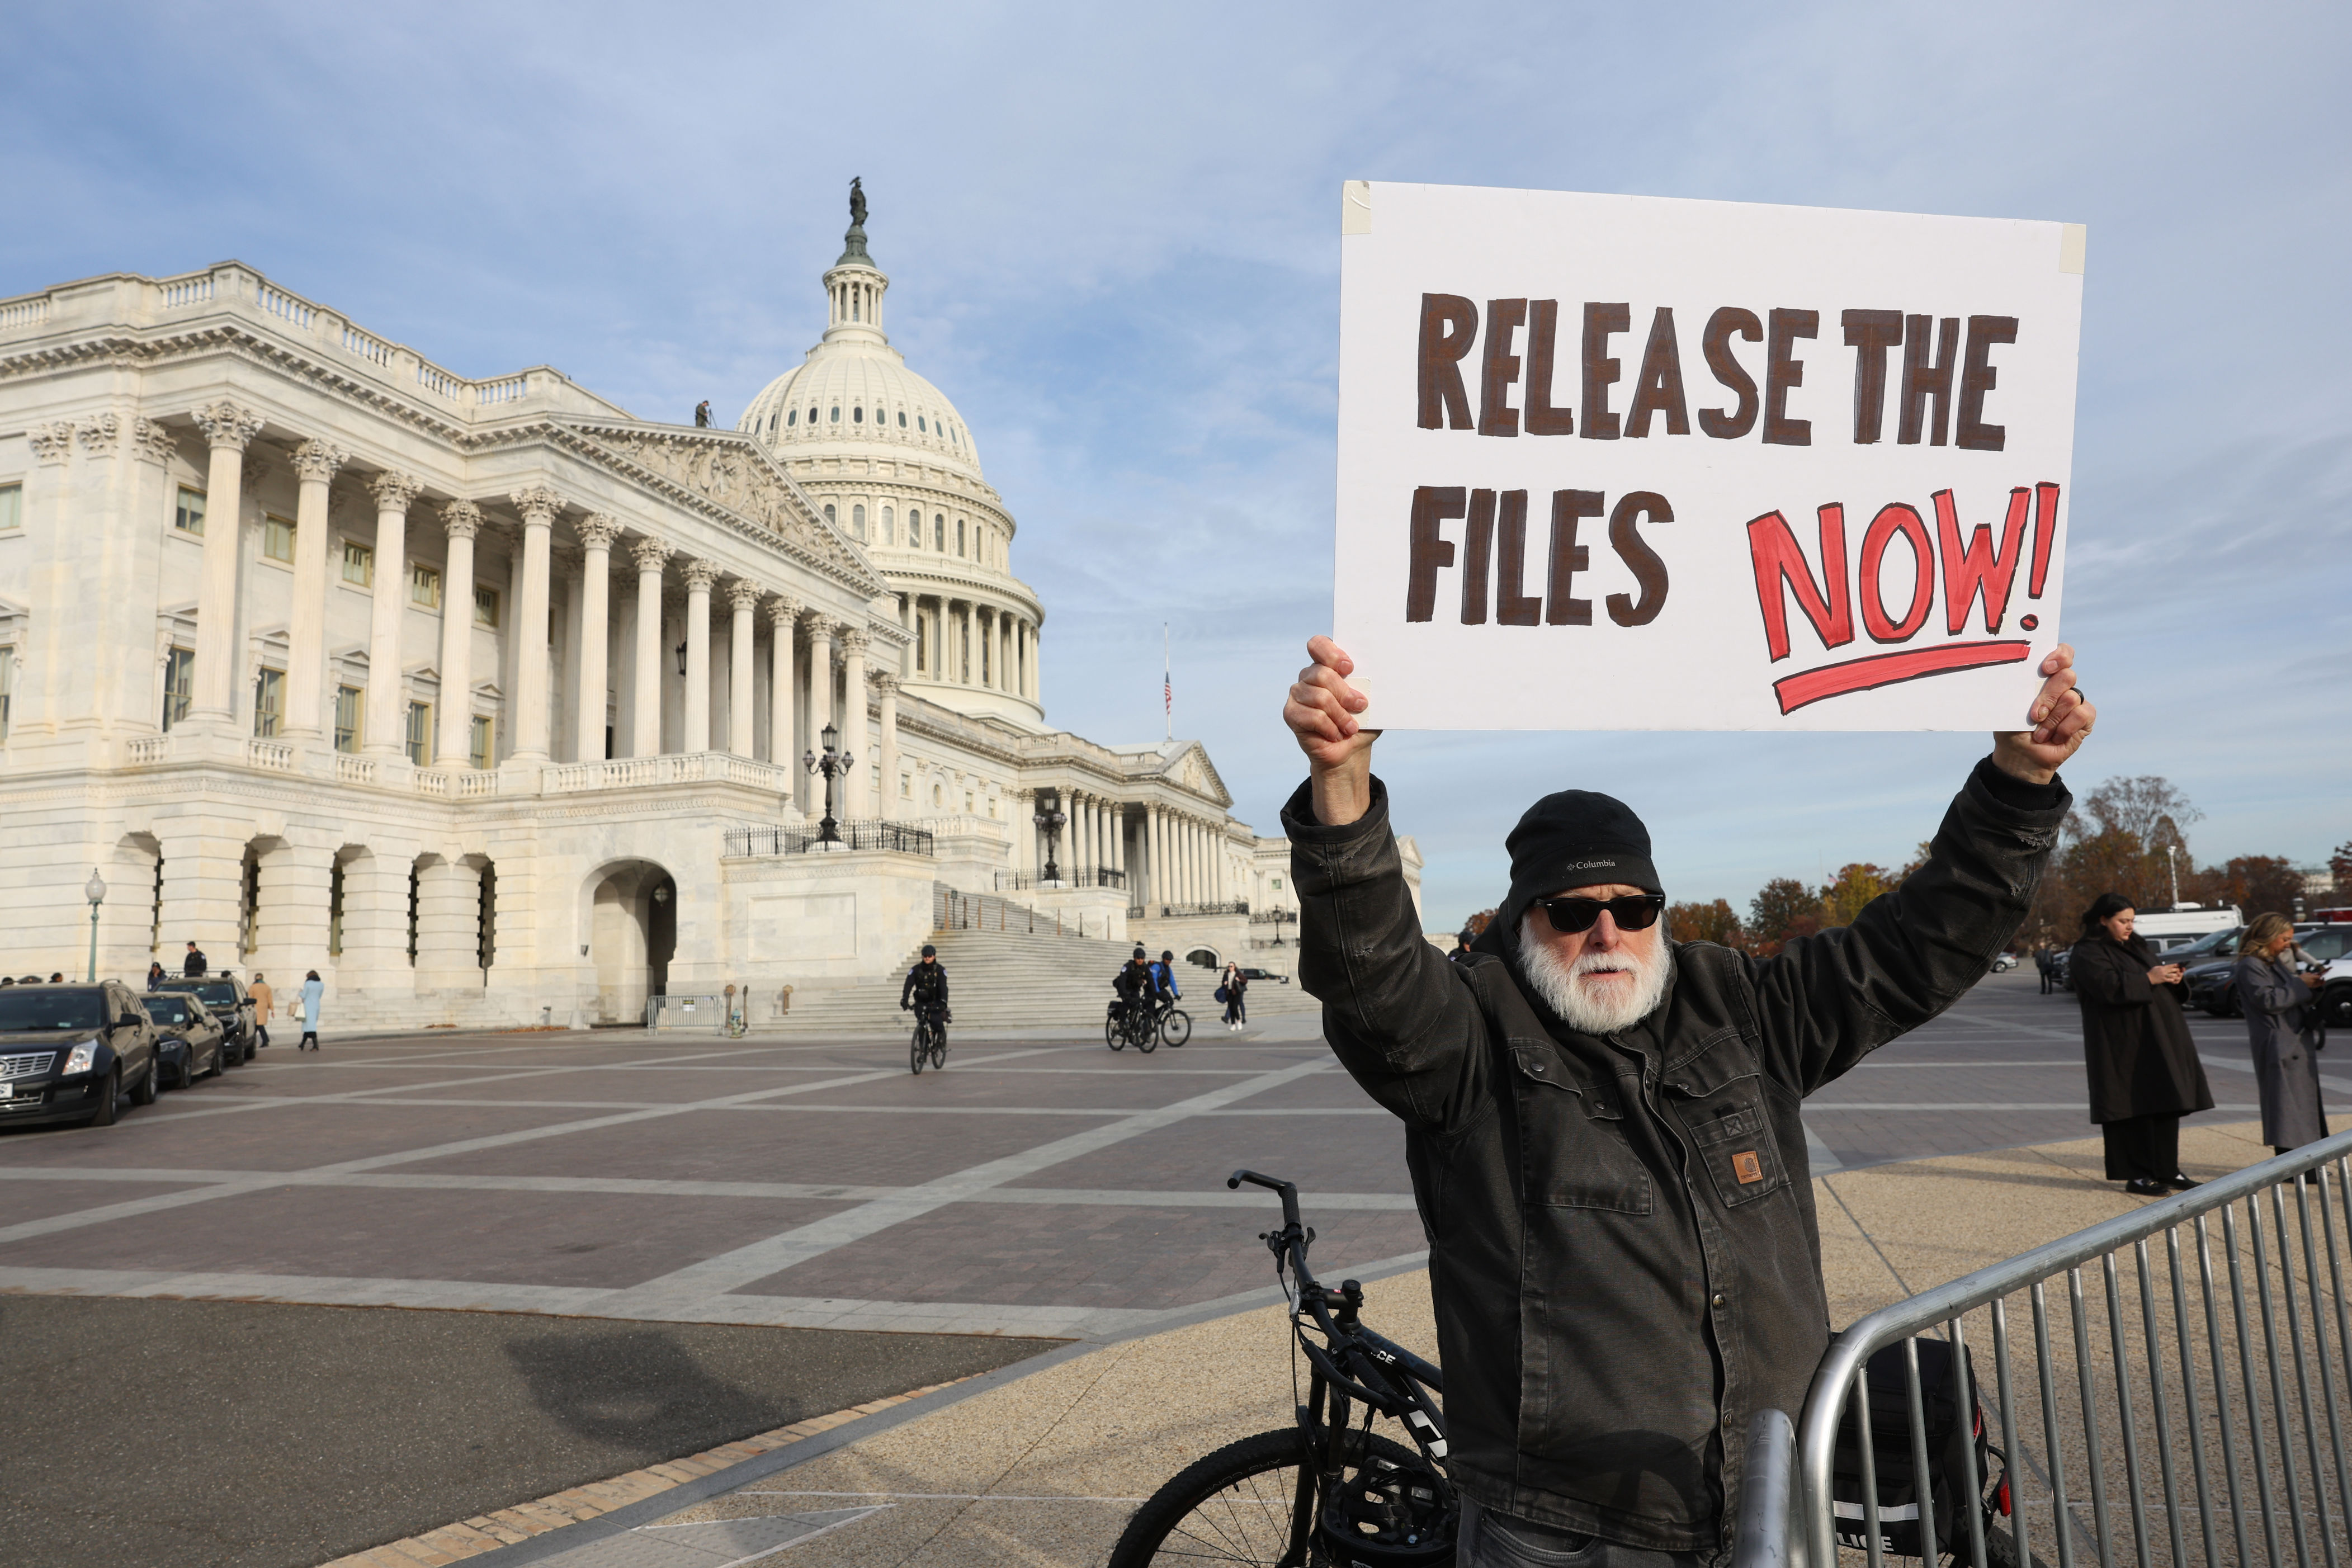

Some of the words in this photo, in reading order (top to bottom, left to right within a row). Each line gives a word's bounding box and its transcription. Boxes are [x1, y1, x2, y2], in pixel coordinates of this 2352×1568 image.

[1417, 292, 1820, 446] RELEASE
[1841, 309, 2019, 452] THE
[1406, 485, 1675, 627] FILES
[1746, 481, 2061, 664] NOW!
[1576, 859, 1616, 869] Columbia
